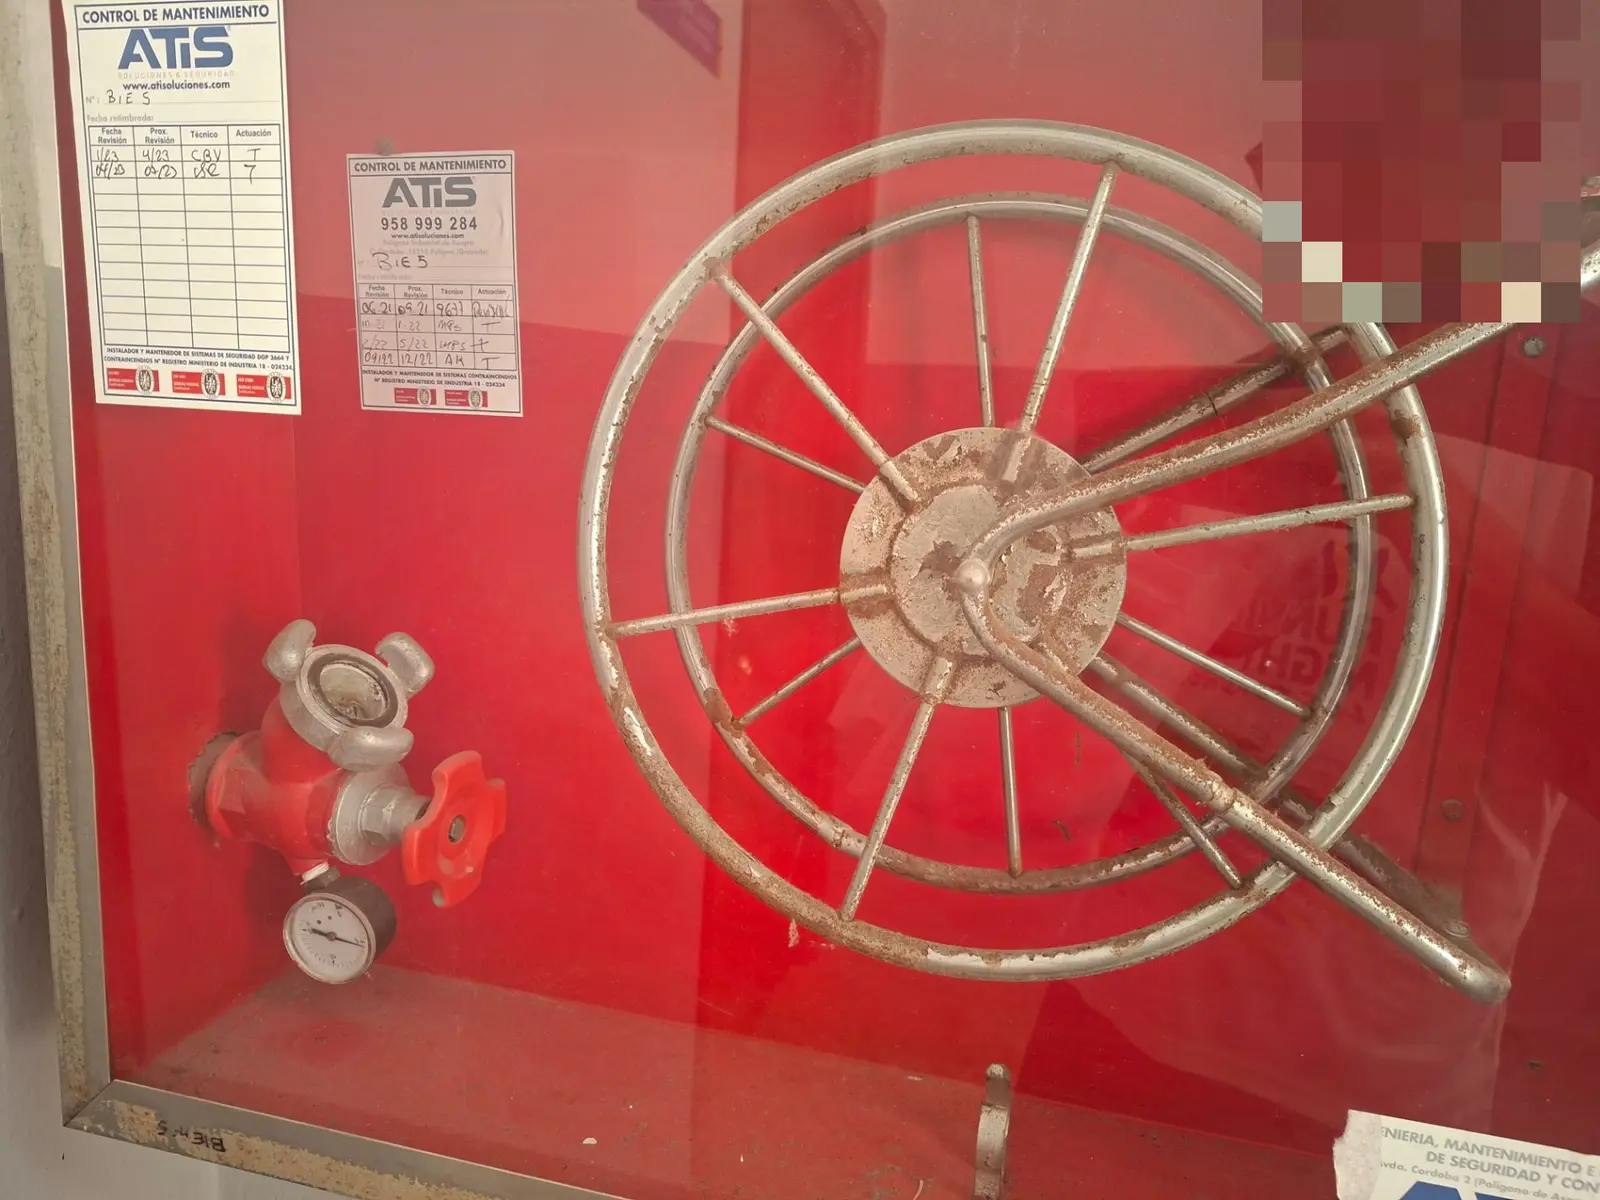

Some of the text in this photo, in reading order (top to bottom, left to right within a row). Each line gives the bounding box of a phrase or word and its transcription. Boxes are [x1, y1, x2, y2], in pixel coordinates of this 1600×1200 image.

[83, 4, 269, 23] CONTROL DE MANTENIMIENTO
[123, 80, 230, 90] www.atisoluciones.com
[87, 113, 107, 121] Fecha
[143, 148, 169, 162] 4/23
[354, 159, 506, 172] CONTROL DE MANTENIMIENTO
[381, 217, 477, 230] 958 999 284
[418, 255, 428, 268] 5
[1444, 1138, 1582, 1173] MANTENIMIENTO
[1426, 1151, 1446, 1164] DE
[1450, 1155, 1540, 1182] SEGURIDAD
[1546, 1173, 1558, 1185] Y
[1412, 1166, 1459, 1181] Cordoba
[1464, 1175, 1470, 1184] 2
[1533, 1190, 1548, 1198] de
